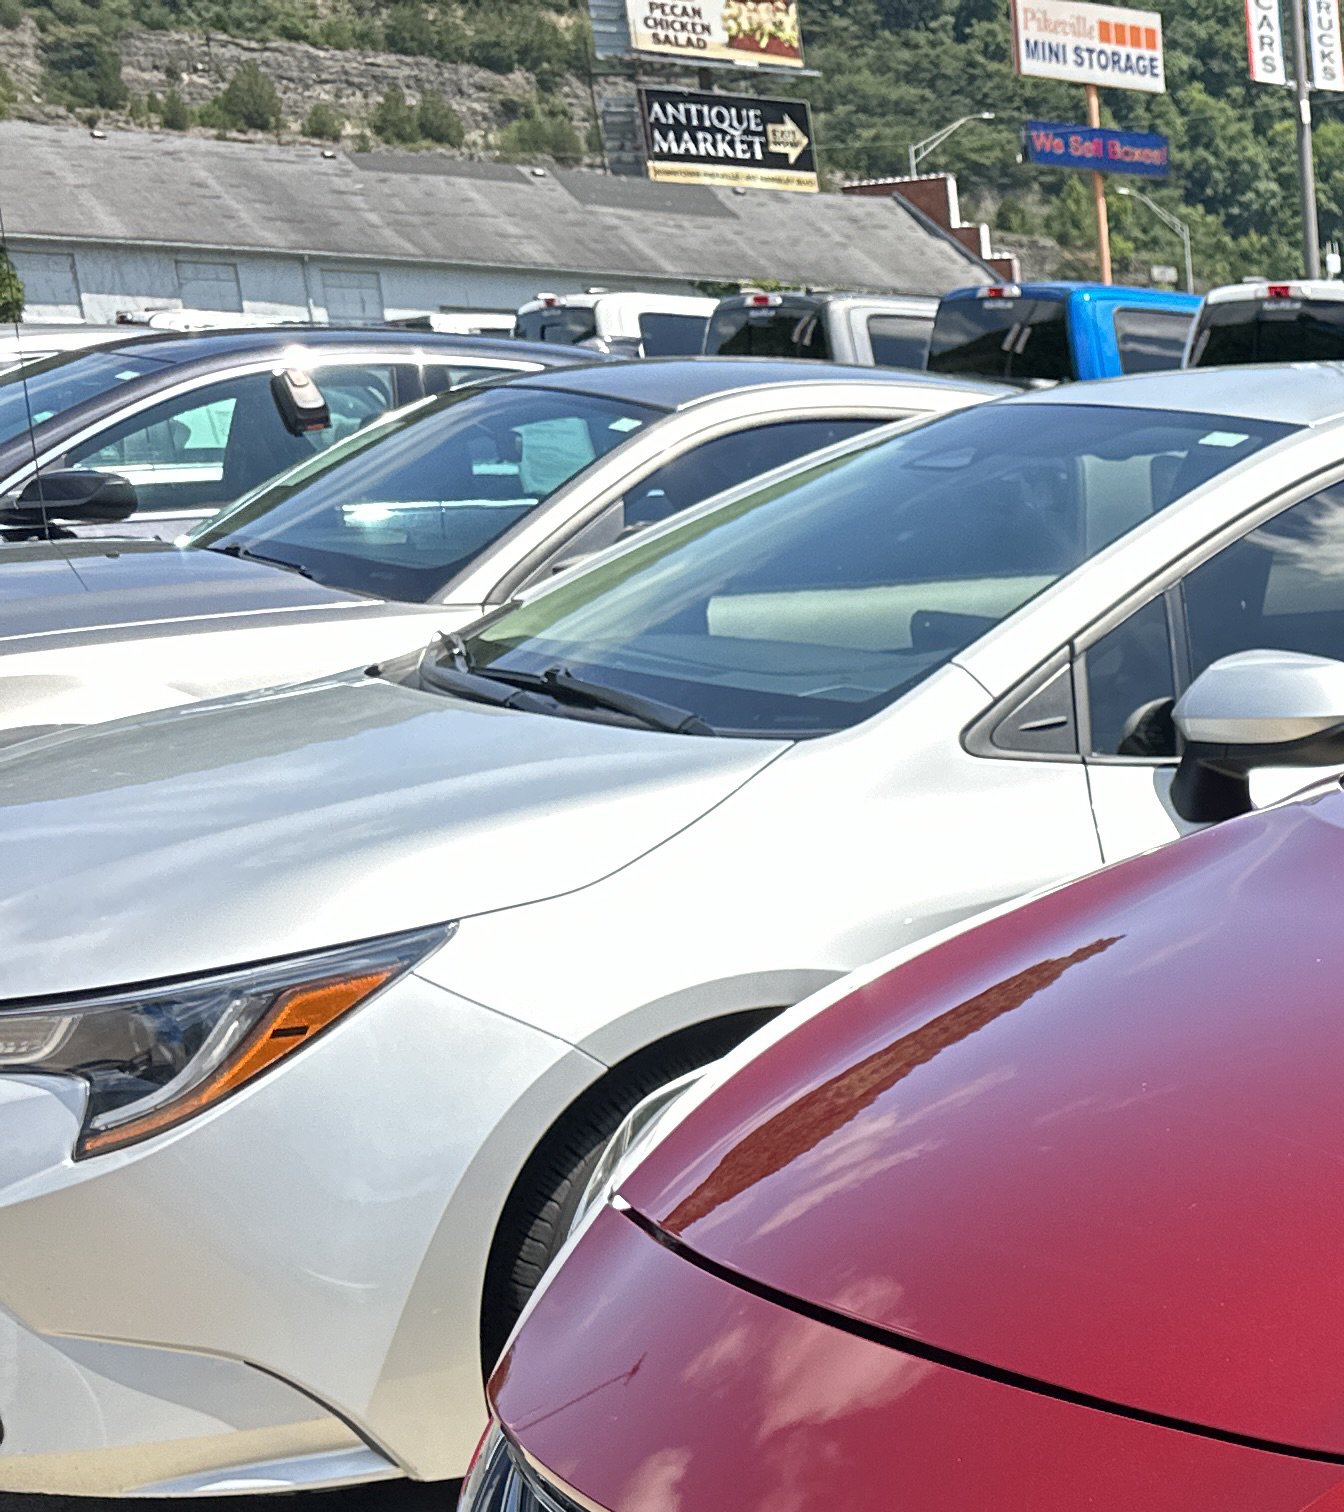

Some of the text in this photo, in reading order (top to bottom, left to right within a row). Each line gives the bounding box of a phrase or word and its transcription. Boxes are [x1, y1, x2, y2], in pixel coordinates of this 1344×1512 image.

[643, 16, 713, 36] CHICKEN
[649, 2, 703, 19] PECAN
[1022, 6, 1097, 40] Pikeville
[652, 32, 708, 50] SALAD
[1255, 0, 1277, 74] CARS
[1025, 38, 1160, 78] MINI STORAGE
[649, 101, 764, 136] ANTIQUE
[653, 128, 767, 160] MARKET
[1031, 131, 1065, 154] We
[1069, 135, 1103, 158] Sell
